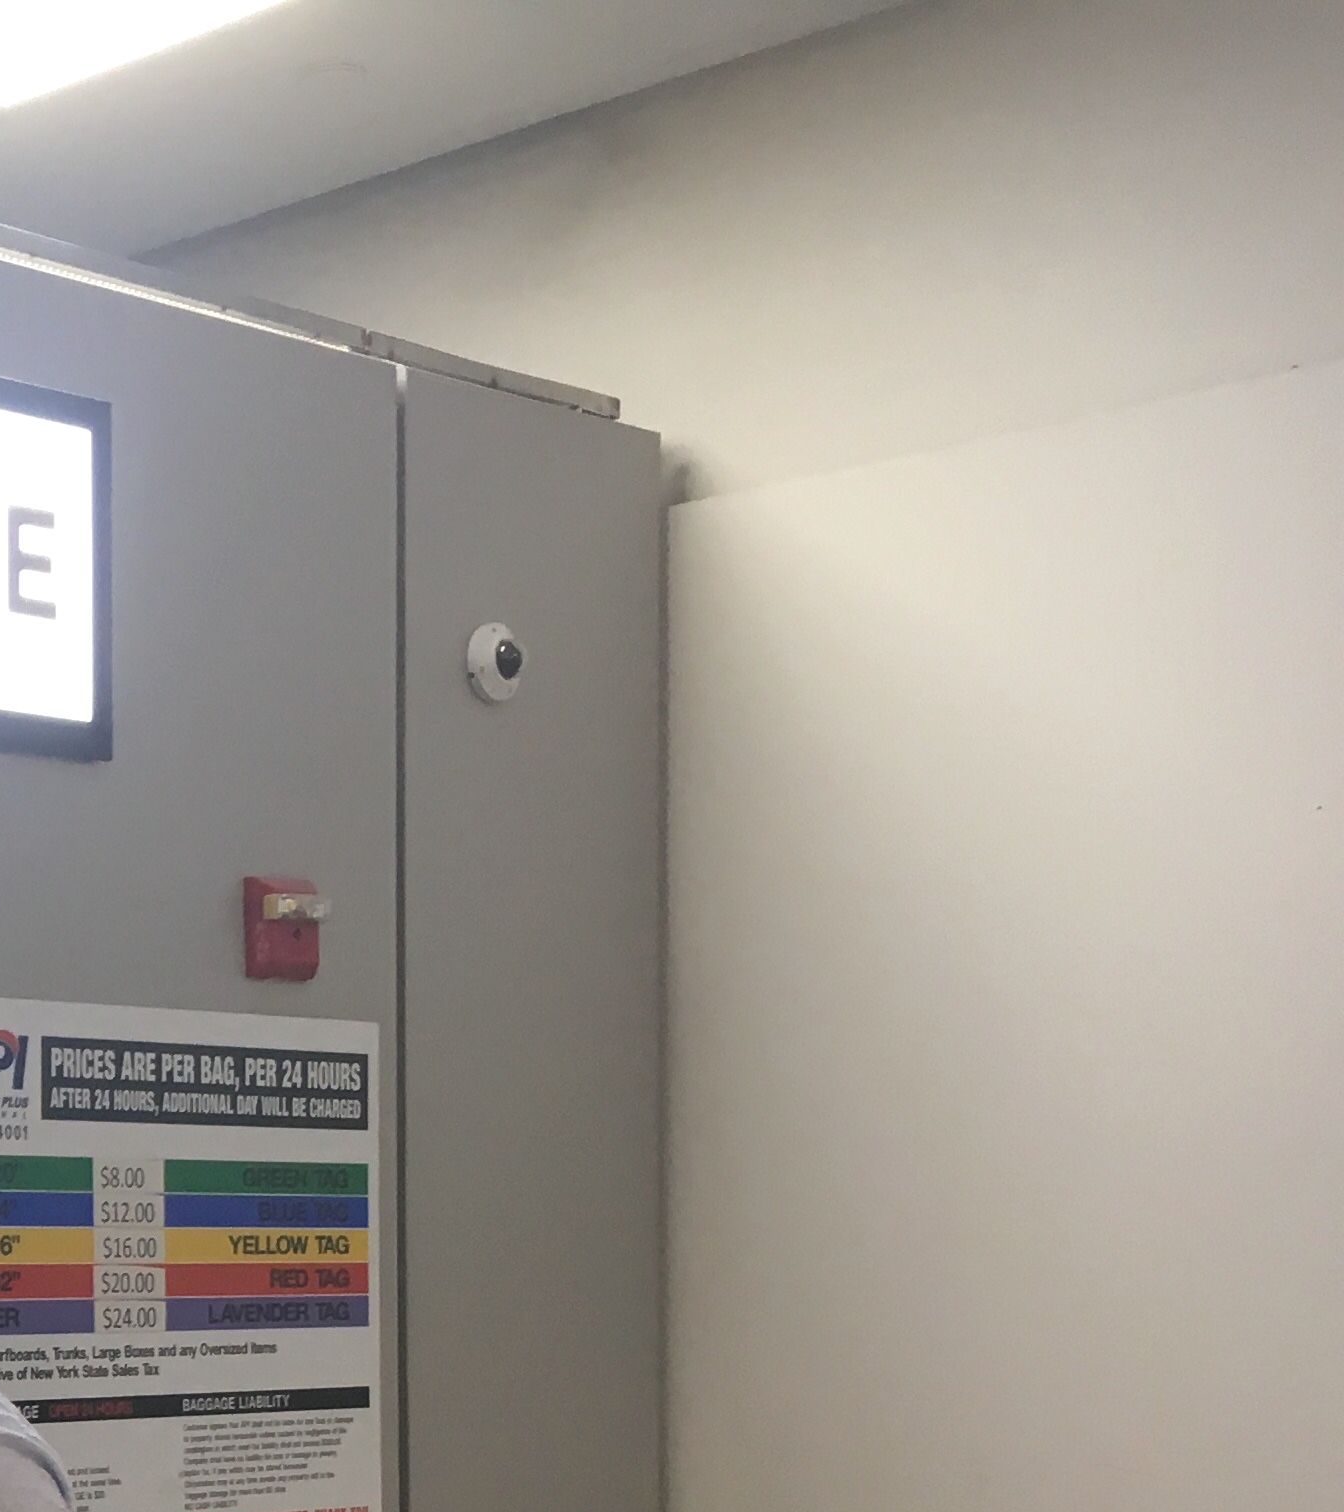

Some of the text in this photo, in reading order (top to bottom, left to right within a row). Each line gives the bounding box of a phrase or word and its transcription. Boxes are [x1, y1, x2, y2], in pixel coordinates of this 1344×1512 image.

[50, 1047, 362, 1092] PRICES ARE PER BAG, PER 24 HOURS
[1, 1096, 30, 1108] PLUS
[50, 1087, 361, 1119] AFTER 24 HOURS, ADDITIONAL DAY WILL BE CHARGED
[100, 1165, 145, 1188] $8.00
[243, 1167, 308, 1188] GREEN
[315, 1168, 349, 1189] TAG
[101, 1200, 155, 1223] $12.00
[258, 1201, 308, 1222] BLUE
[314, 1202, 349, 1222] TAG
[103, 1237, 157, 1259] $16.00
[228, 1235, 309, 1255] YELLOW
[315, 1235, 350, 1255] TAG
[101, 1271, 155, 1294] $20.00
[269, 1268, 309, 1289] RED
[316, 1268, 351, 1289] TAG
[102, 1307, 157, 1329] $24.00
[208, 1303, 310, 1324] LAVENDER
[315, 1302, 351, 1322] TAG
[53, 1346, 89, 1361] Trunks,
[92, 1345, 122, 1362] Large
[124, 1345, 155, 1358] Boxes
[158, 1345, 177, 1357] and
[179, 1346, 197, 1359] any
[199, 1342, 248, 1356] Oversized
[16, 1366, 28, 1380] of
[30, 1366, 54, 1380] New
[56, 1365, 80, 1379] York
[82, 1364, 109, 1378] State
[111, 1363, 140, 1377] Sales
[142, 1362, 160, 1376] Tax
[182, 1394, 290, 1412] BAGGAGE LIABILITY
